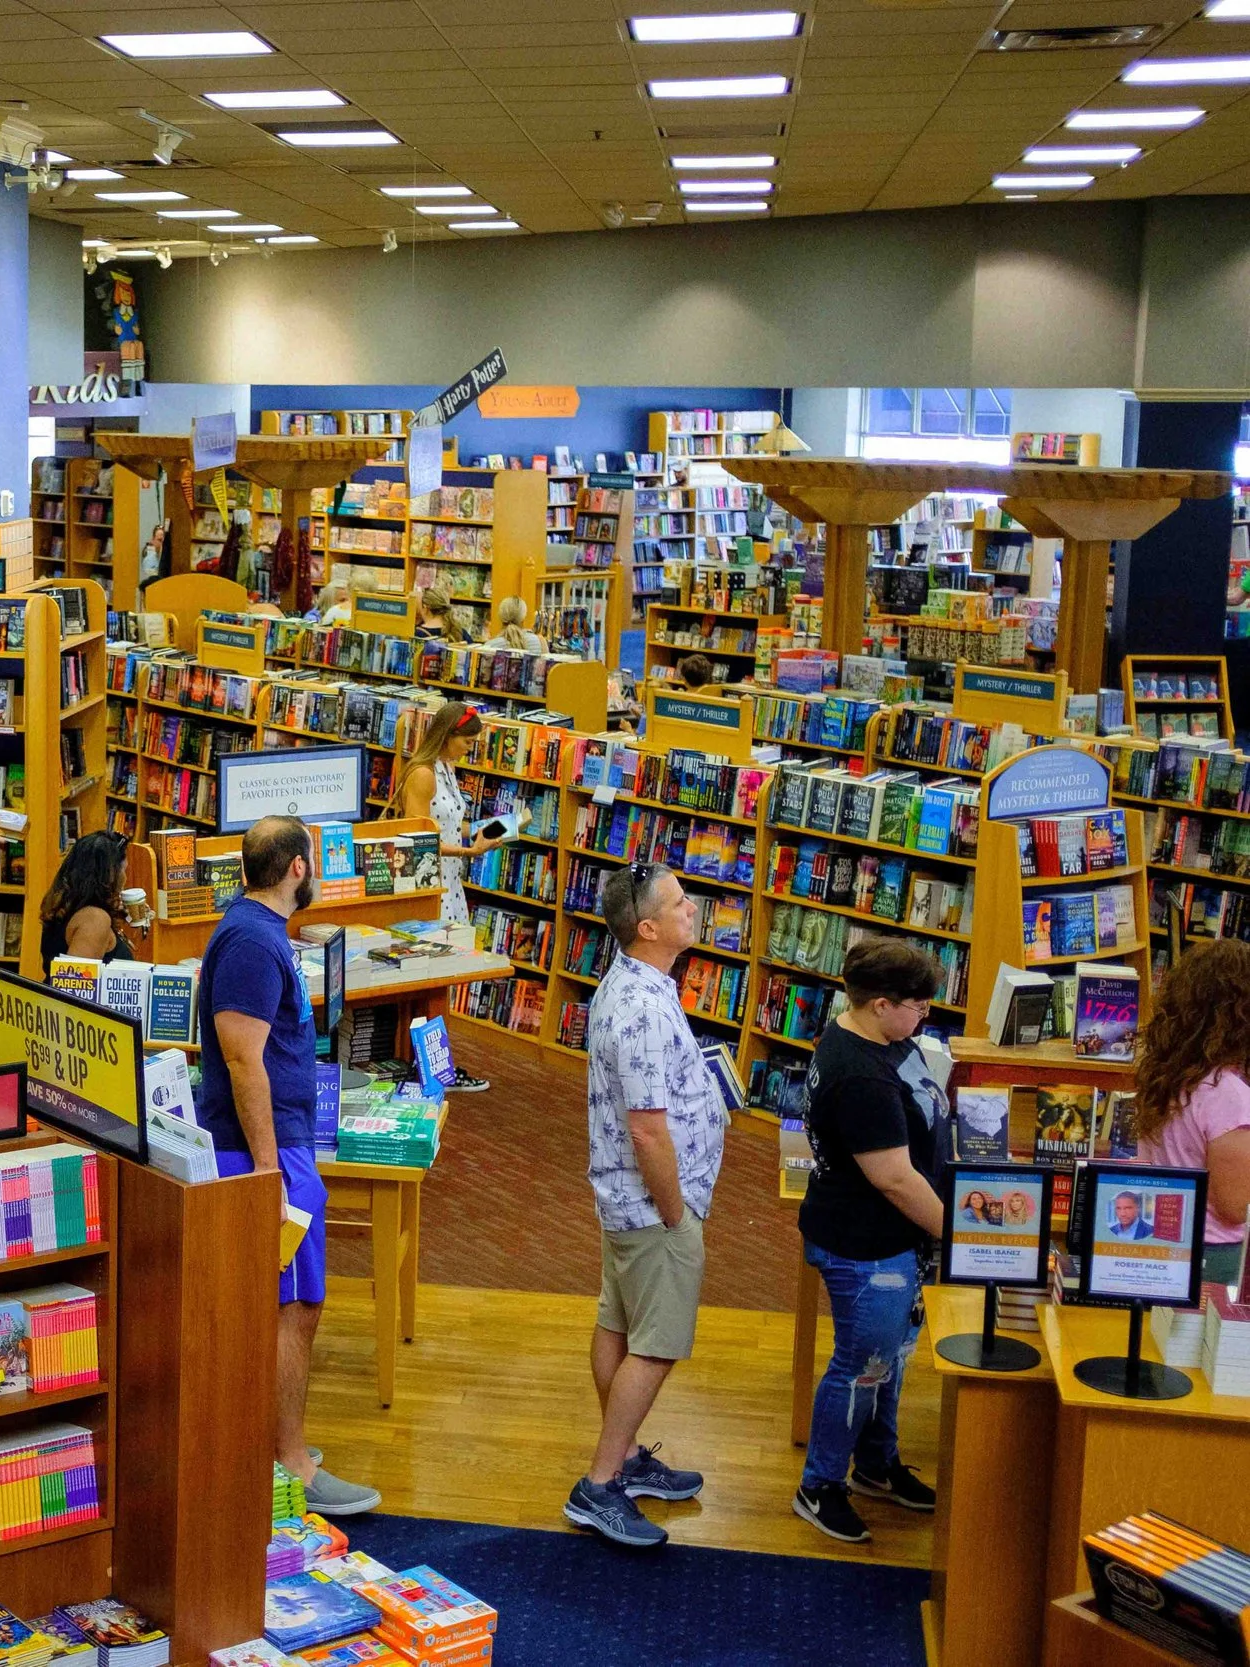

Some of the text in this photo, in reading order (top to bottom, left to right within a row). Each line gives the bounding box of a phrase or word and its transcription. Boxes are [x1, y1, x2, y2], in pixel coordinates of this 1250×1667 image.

[31, 373, 120, 404] Kids
[442, 353, 501, 415] Harry Potter
[977, 678, 1042, 694] MYSTERY / THRILLER
[668, 704, 728, 721] MYSTERY / THRILLER
[239, 772, 346, 789] CLASSIC & CONTEMPORARY
[1011, 774, 1090, 792] RECOMMENDED
[241, 784, 344, 800] FAVORITES IN FICTION
[786, 784, 803, 798] PULL
[818, 788, 835, 801] PULL
[782, 798, 803, 810] STARS
[853, 795, 870, 806] PULL
[997, 788, 1099, 809] MYSTERY & THRILLER
[814, 804, 835, 815] STARS
[168, 871, 194, 880] CIRCE
[326, 864, 351, 875] LOVERS
[1063, 863, 1082, 875] FAR
[214, 880, 240, 890] GUEST
[219, 888, 235, 897] LIST
[52, 977, 95, 991] PARENTS,
[106, 978, 142, 992] COLLEGE
[76, 990, 93, 1000] YOU
[108, 992, 138, 1005] BOUND
[154, 988, 190, 997] COLLEGE
[1085, 1000, 1137, 1025] 1776
[66, 1017, 118, 1065] BOOKS
[55, 1050, 64, 1080] &
[68, 1054, 88, 1089] UP
[27, 1083, 98, 1123] AVE 50% OR MORE!
[1037, 1139, 1088, 1154] WASHINGTON
[1102, 1246, 1144, 1256] VIRTUAL
[1114, 1261, 1143, 1269] ROBERT
[436, 1627, 483, 1644] First Numbers
[448, 1650, 478, 1664] Numbers
